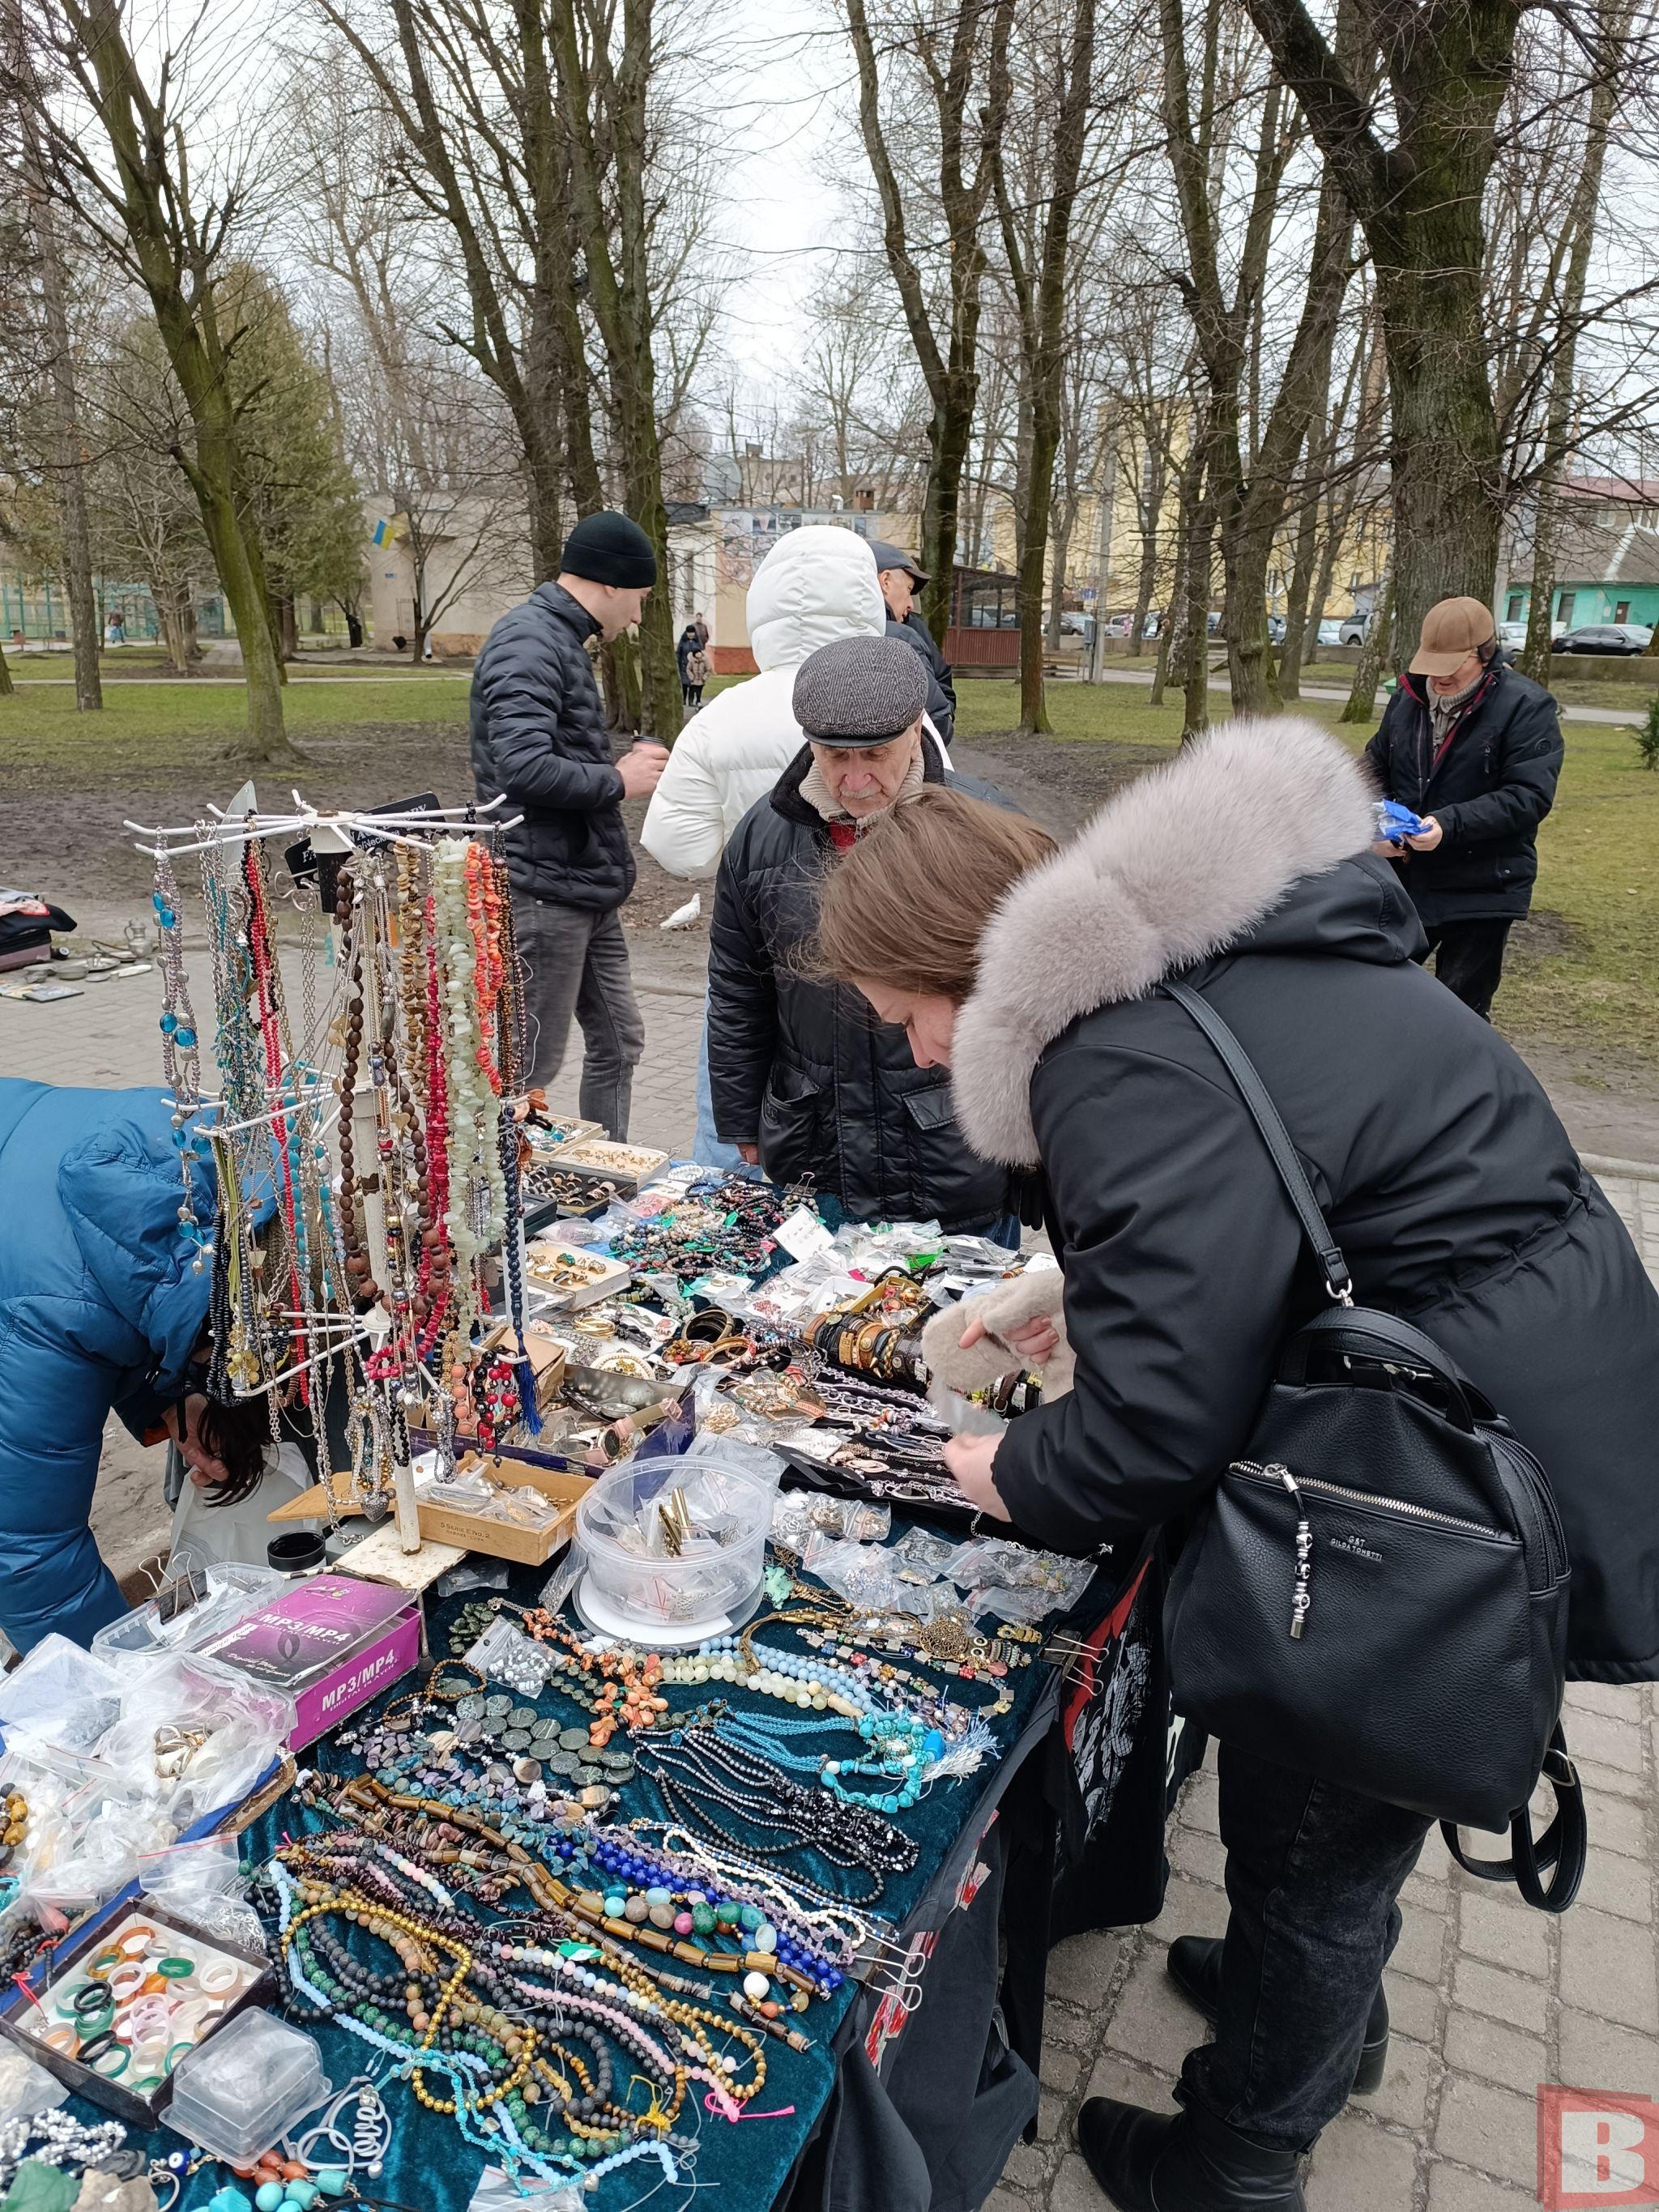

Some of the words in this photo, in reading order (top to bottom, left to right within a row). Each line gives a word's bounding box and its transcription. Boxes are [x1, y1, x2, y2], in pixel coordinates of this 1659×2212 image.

[1331, 1538, 1351, 1551] GILDA
[1348, 1535, 1366, 1548] G&T
[258, 1613, 351, 1643] MP3/MP4
[322, 1648, 394, 1711] MP3/MP4
